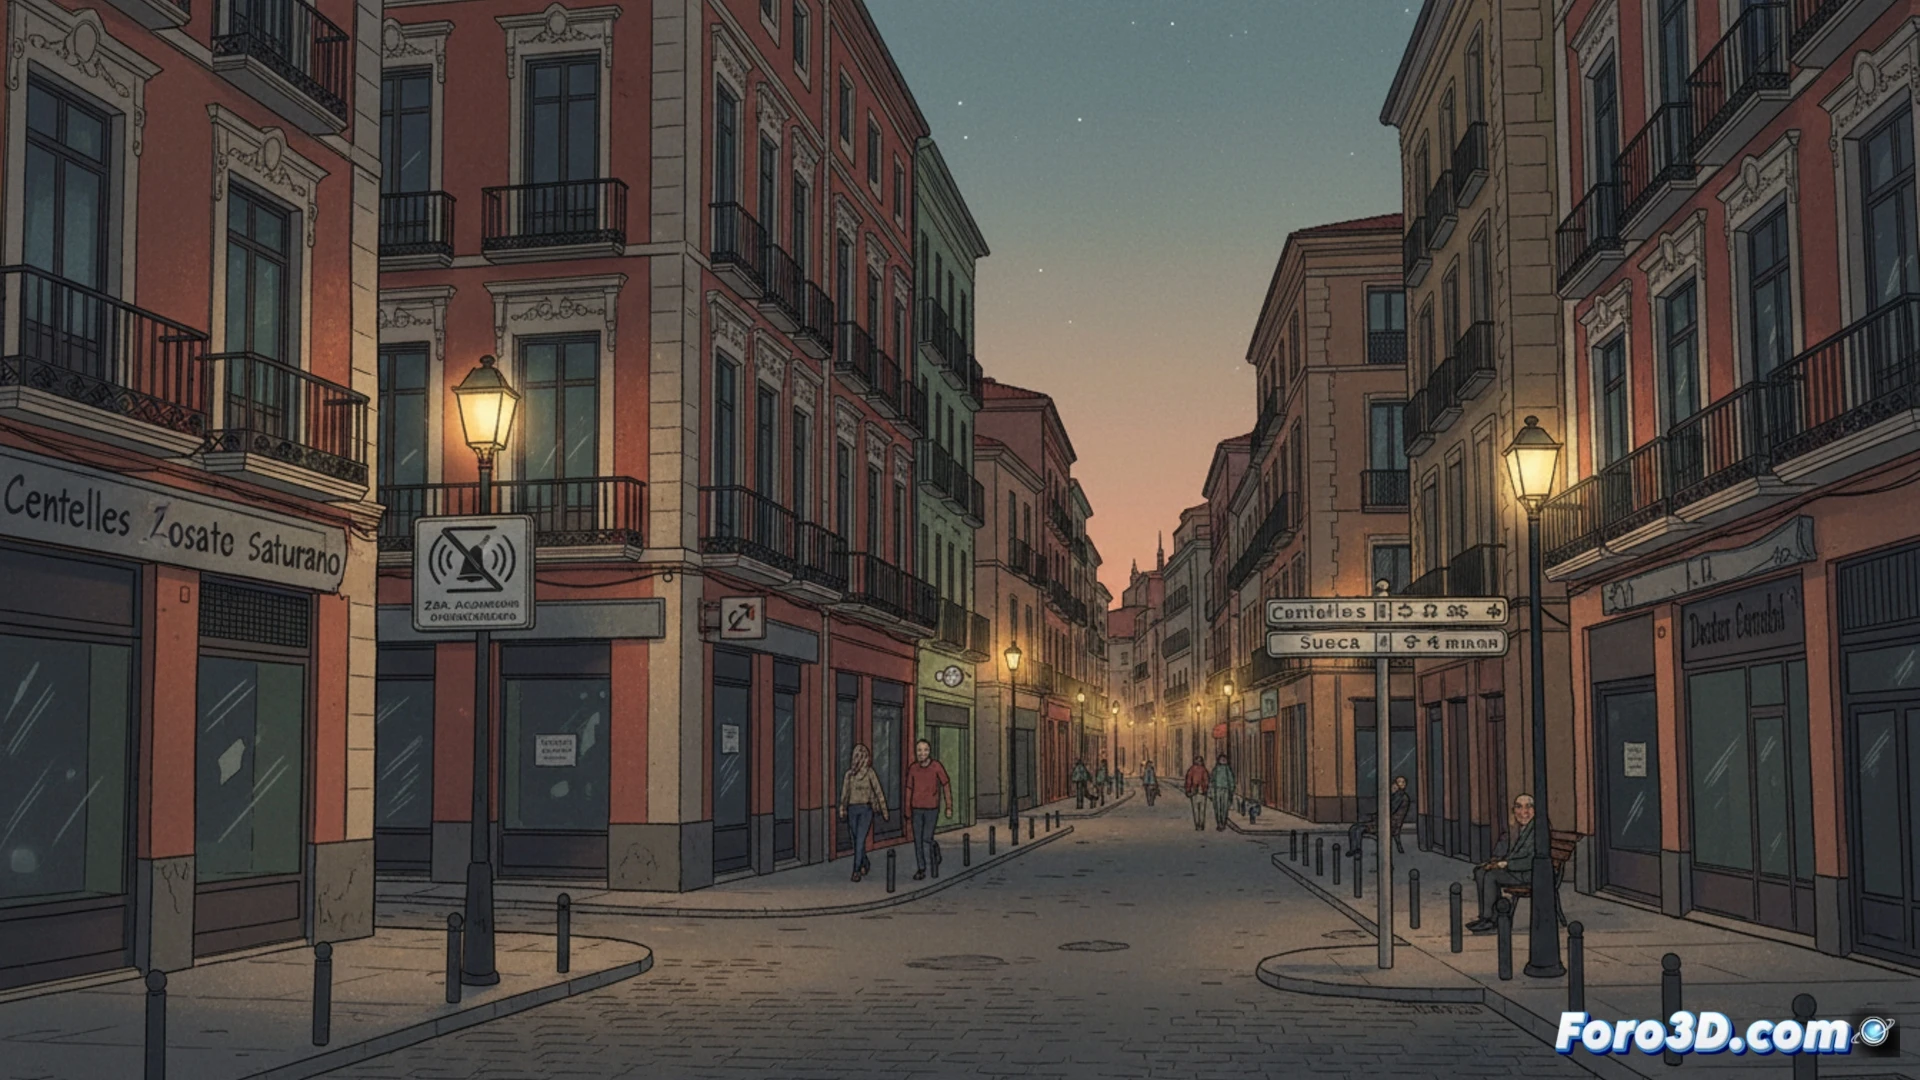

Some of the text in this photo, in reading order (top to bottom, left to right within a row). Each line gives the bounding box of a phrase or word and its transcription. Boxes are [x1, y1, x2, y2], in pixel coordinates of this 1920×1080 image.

[4, 474, 130, 536] Centelles
[248, 531, 341, 576] Saturano
[1300, 635, 1360, 650] Sueca
